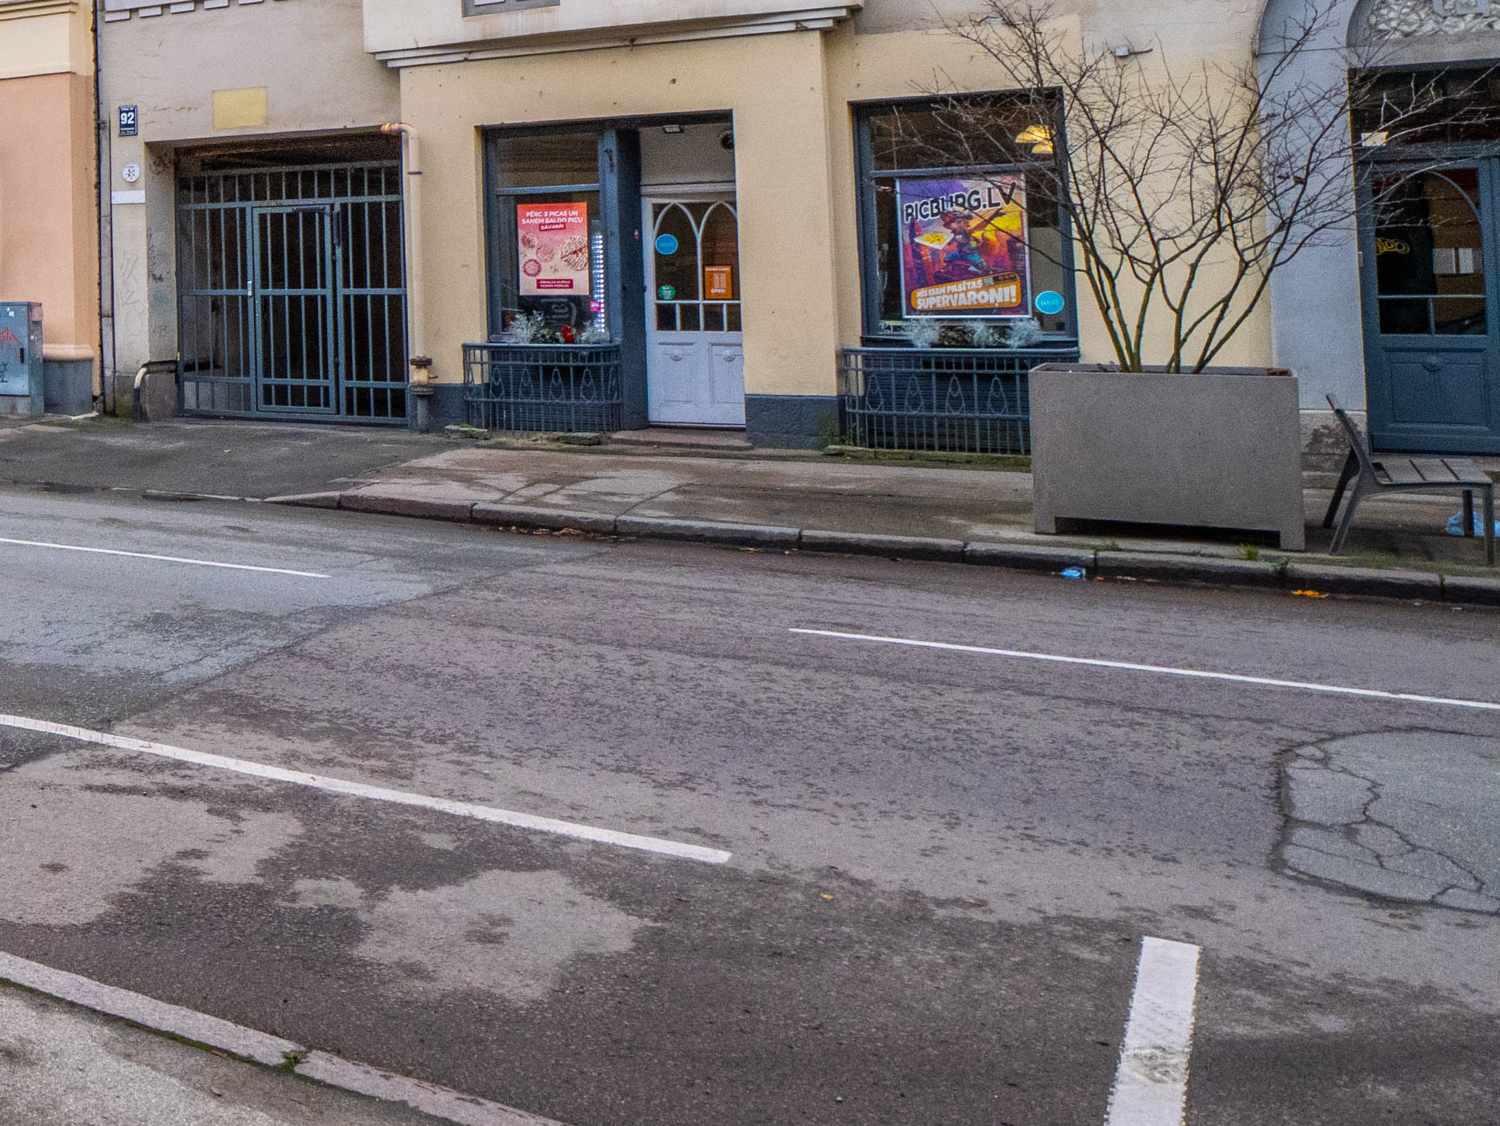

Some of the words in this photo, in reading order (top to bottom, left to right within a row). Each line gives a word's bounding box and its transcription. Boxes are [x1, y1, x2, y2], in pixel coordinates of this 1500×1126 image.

[120, 112, 135, 124] 92
[946, 279, 982, 293] PILSĒTAS
[916, 285, 1017, 310] SUPERVAROŅI!
